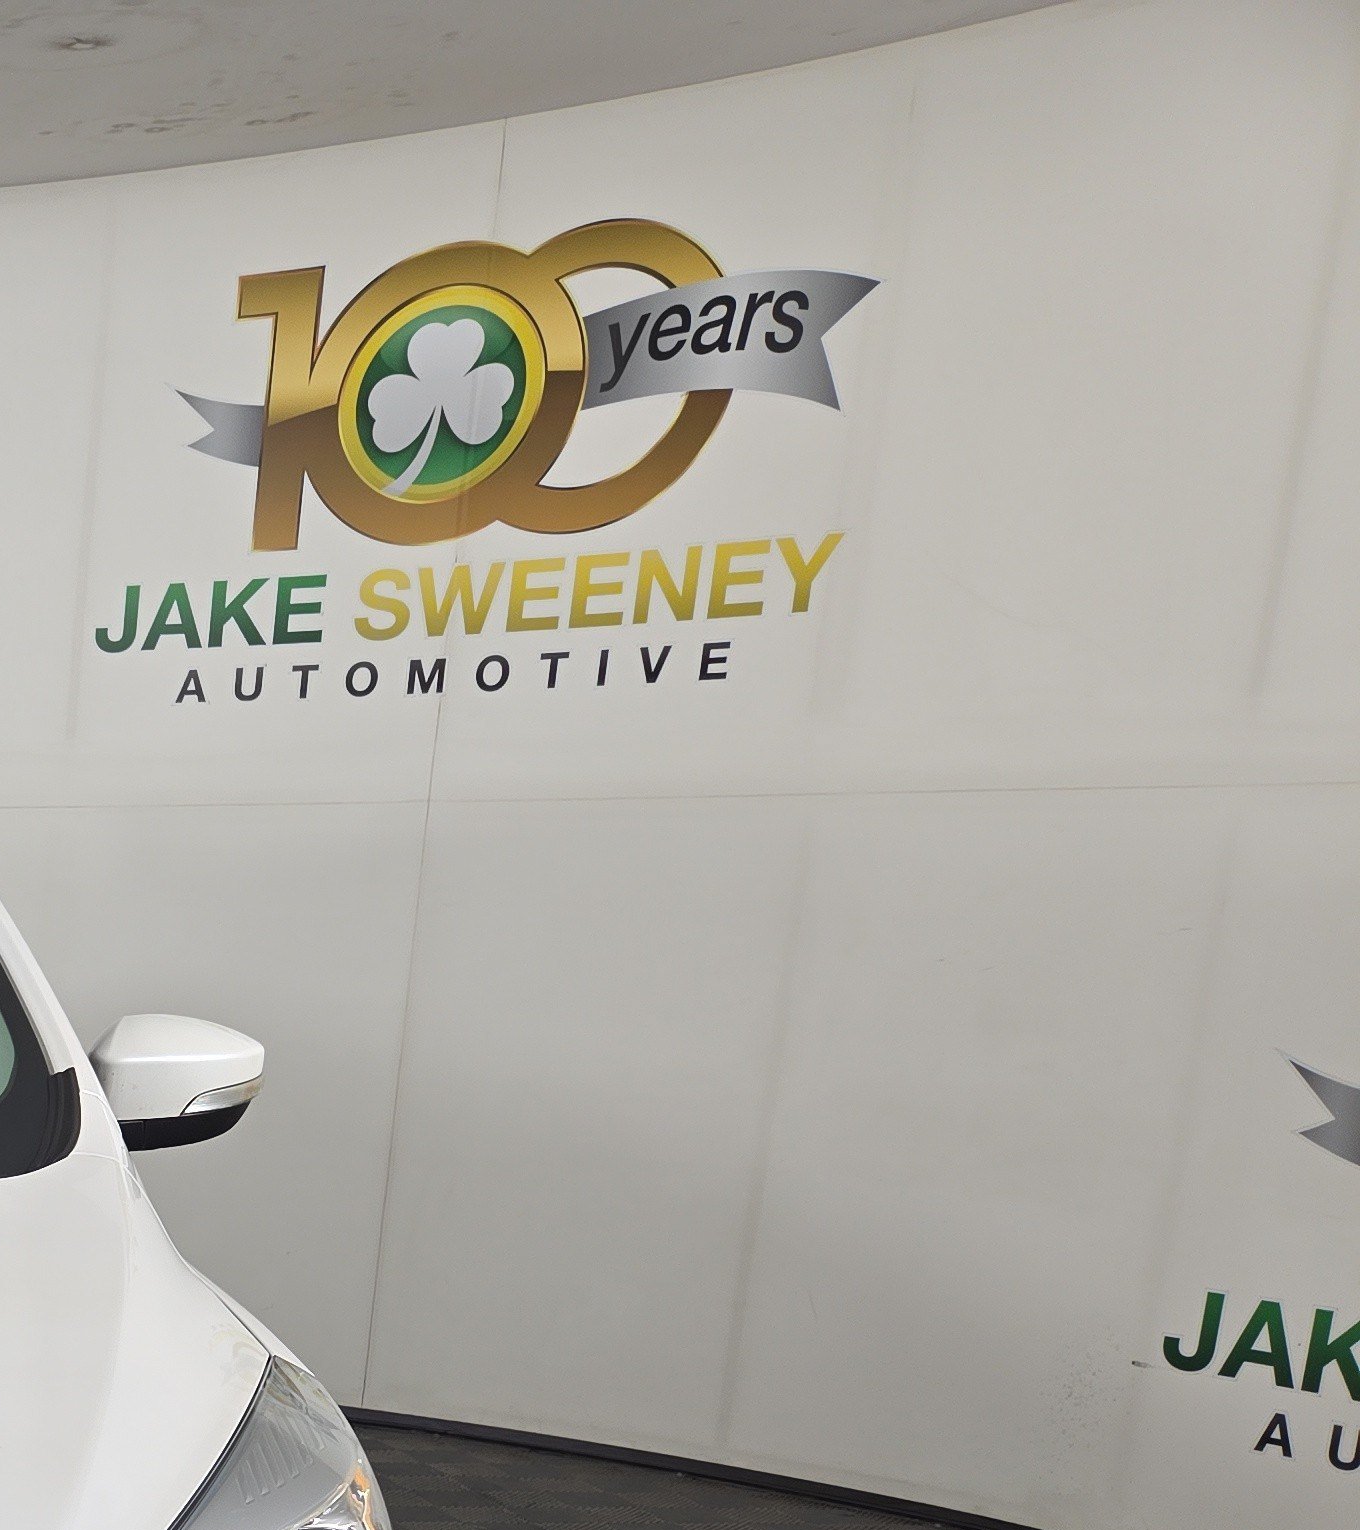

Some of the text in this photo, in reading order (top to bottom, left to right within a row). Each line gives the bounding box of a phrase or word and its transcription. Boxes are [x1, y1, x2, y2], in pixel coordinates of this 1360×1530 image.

[600, 290, 809, 393] years
[95, 532, 845, 653] JAKE SWEENEY
[176, 641, 732, 704] AUTOMOTIVE
[1163, 1292, 1360, 1402] JAK
[1254, 1412, 1360, 1471] AU
